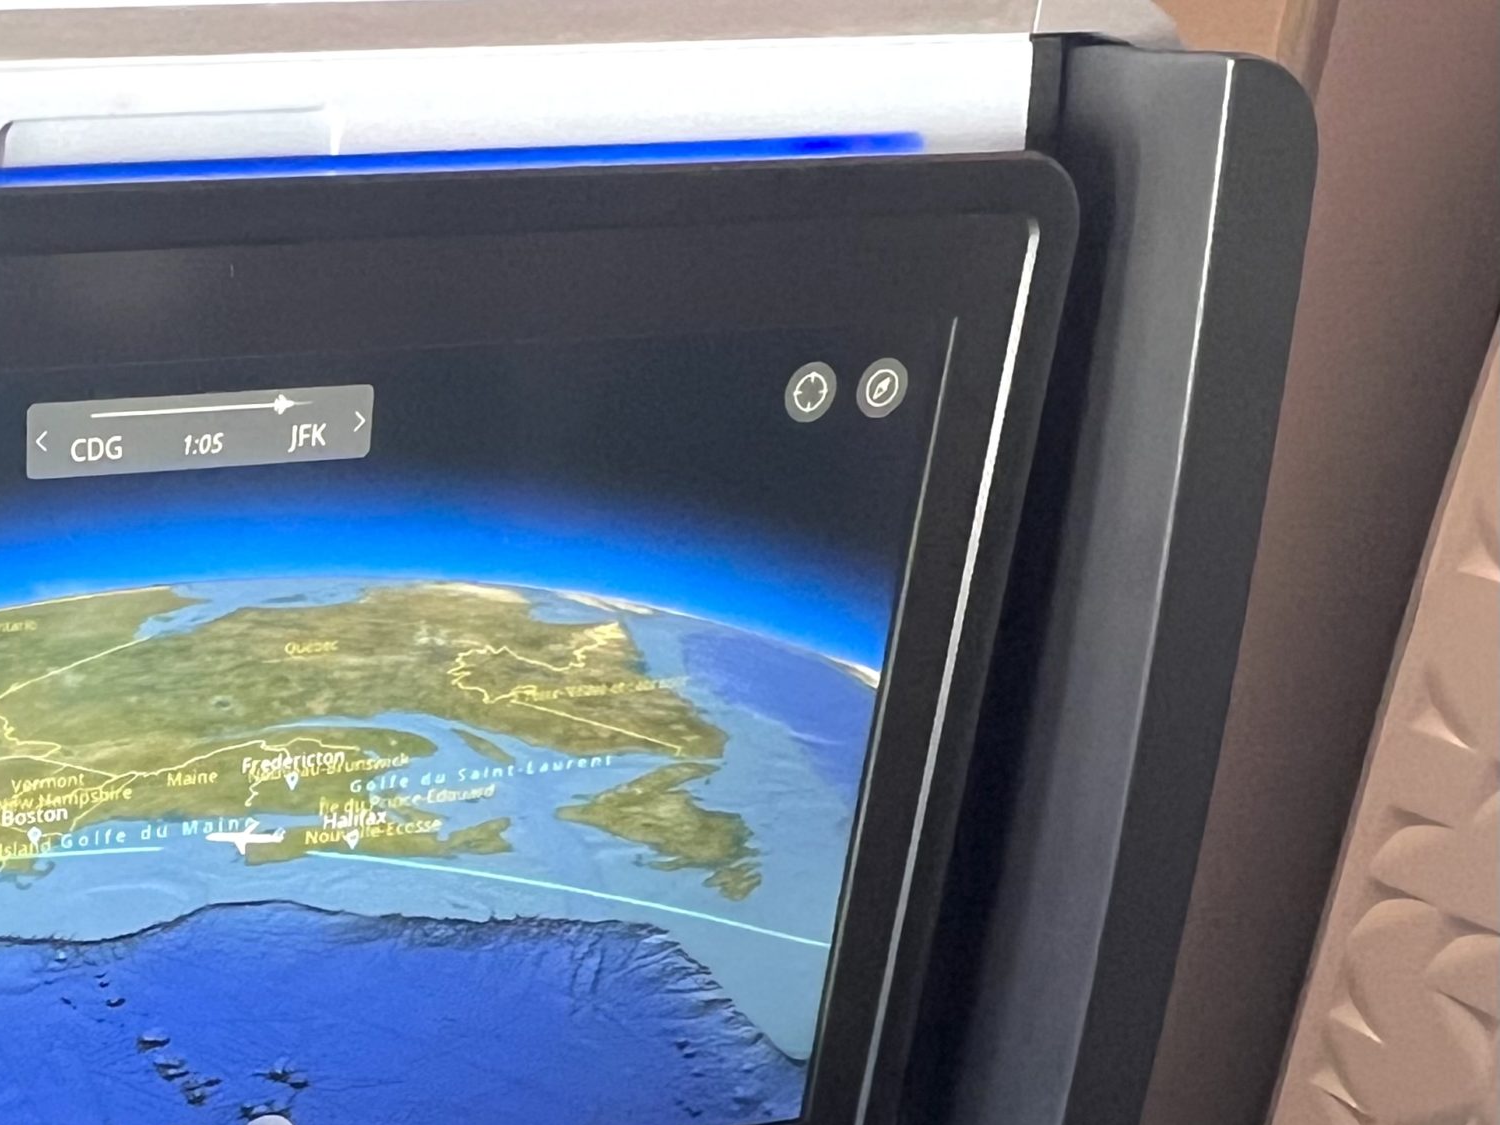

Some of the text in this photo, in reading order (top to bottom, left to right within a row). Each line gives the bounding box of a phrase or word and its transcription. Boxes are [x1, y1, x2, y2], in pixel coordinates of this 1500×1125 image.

[70, 423, 327, 462] CDG 1:05 JFK
[242, 751, 345, 774] Fredericton
[350, 755, 613, 793] Golfe du Saint-Laurent
[167, 769, 219, 787] Maine
[1, 807, 69, 827] Boston
[322, 809, 387, 830] Halifax
[60, 828, 127, 848] Golfe
[141, 824, 168, 840] du
